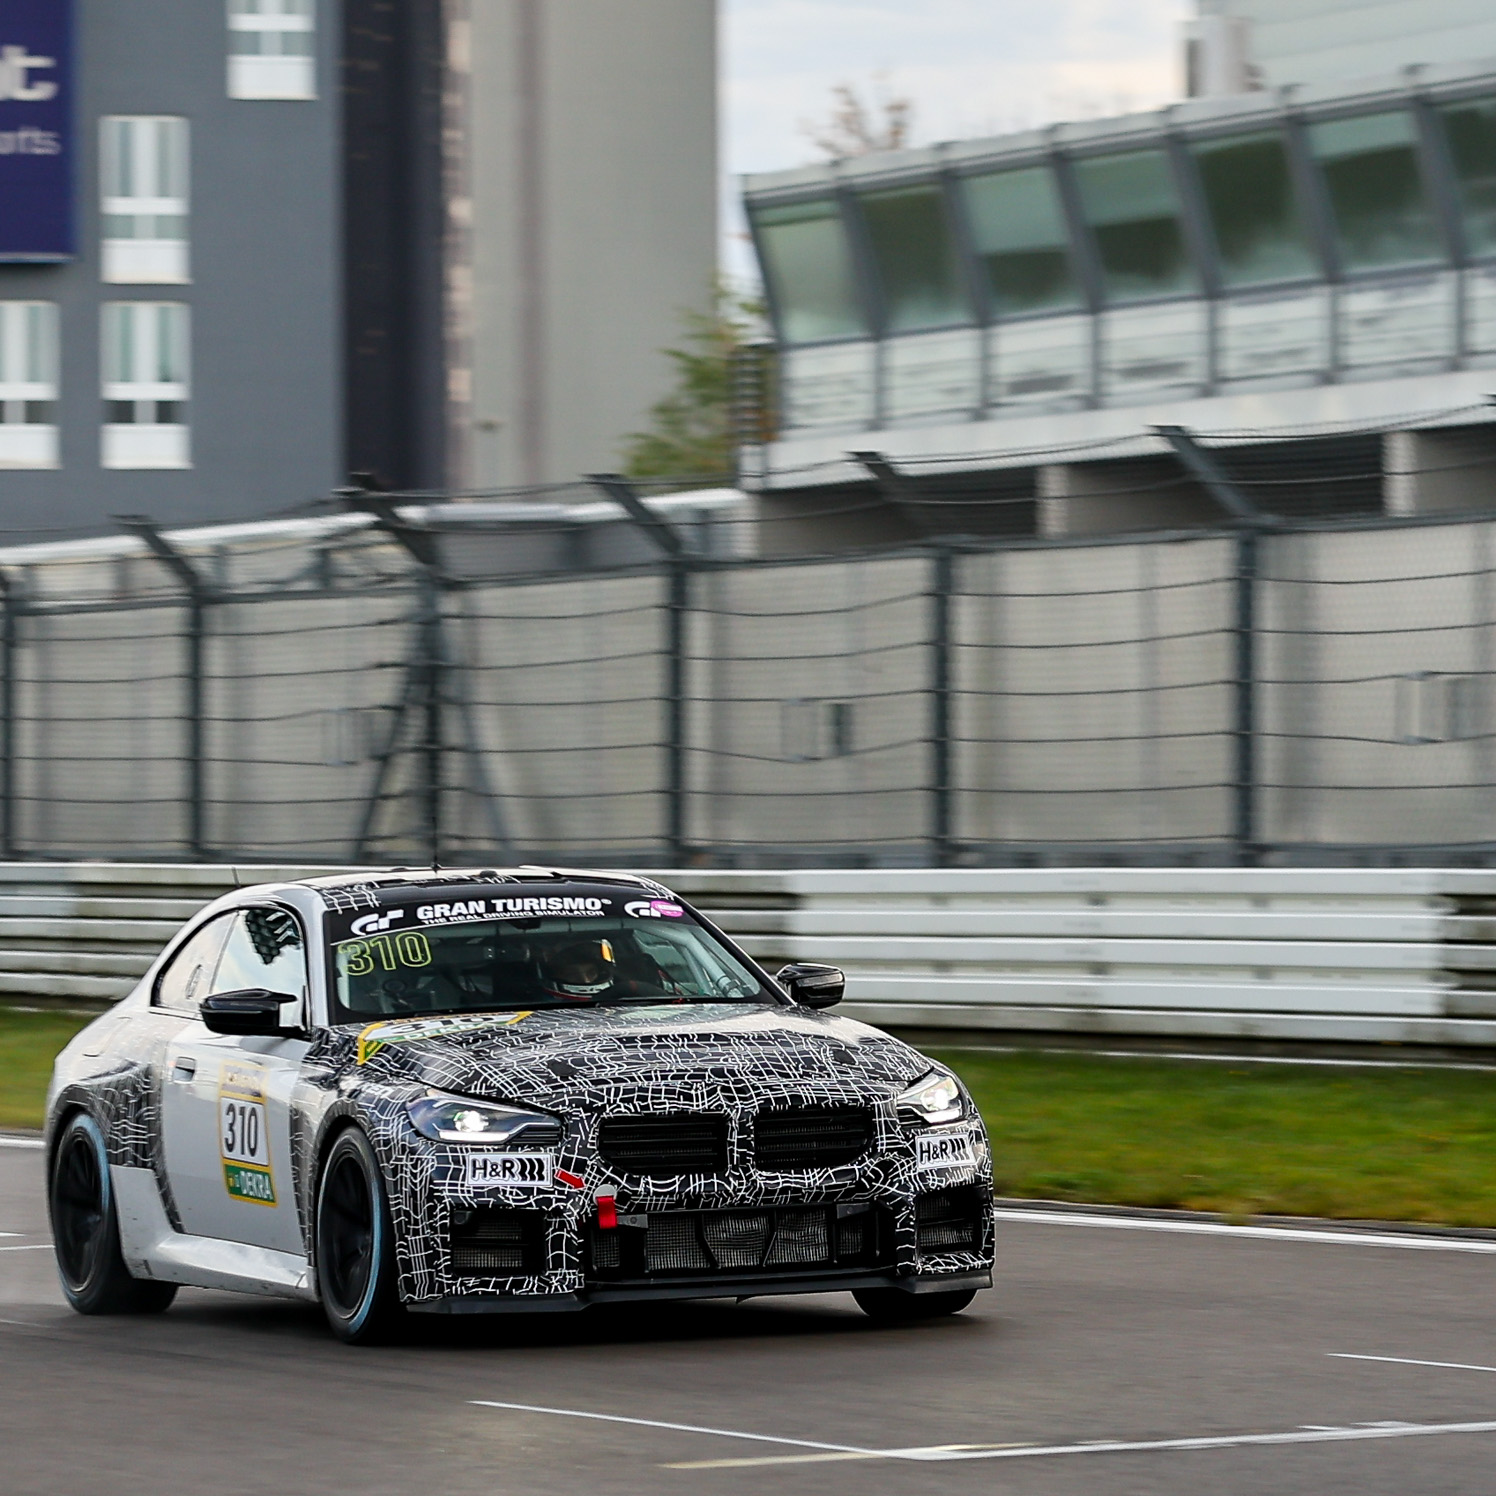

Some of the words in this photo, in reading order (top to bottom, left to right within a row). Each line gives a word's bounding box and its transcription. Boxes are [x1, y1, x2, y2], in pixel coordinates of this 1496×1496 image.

[416, 900, 486, 920] GRAN
[421, 917, 447, 925] THE
[449, 914, 482, 922] REAL
[483, 910, 534, 920] DRIVING
[535, 909, 605, 917] SIMULATOR
[338, 931, 432, 976] 310
[224, 1103, 259, 1158] 310
[919, 1139, 950, 1163] H&R
[471, 1157, 515, 1180] H&R
[239, 1170, 274, 1200] DEKRA
